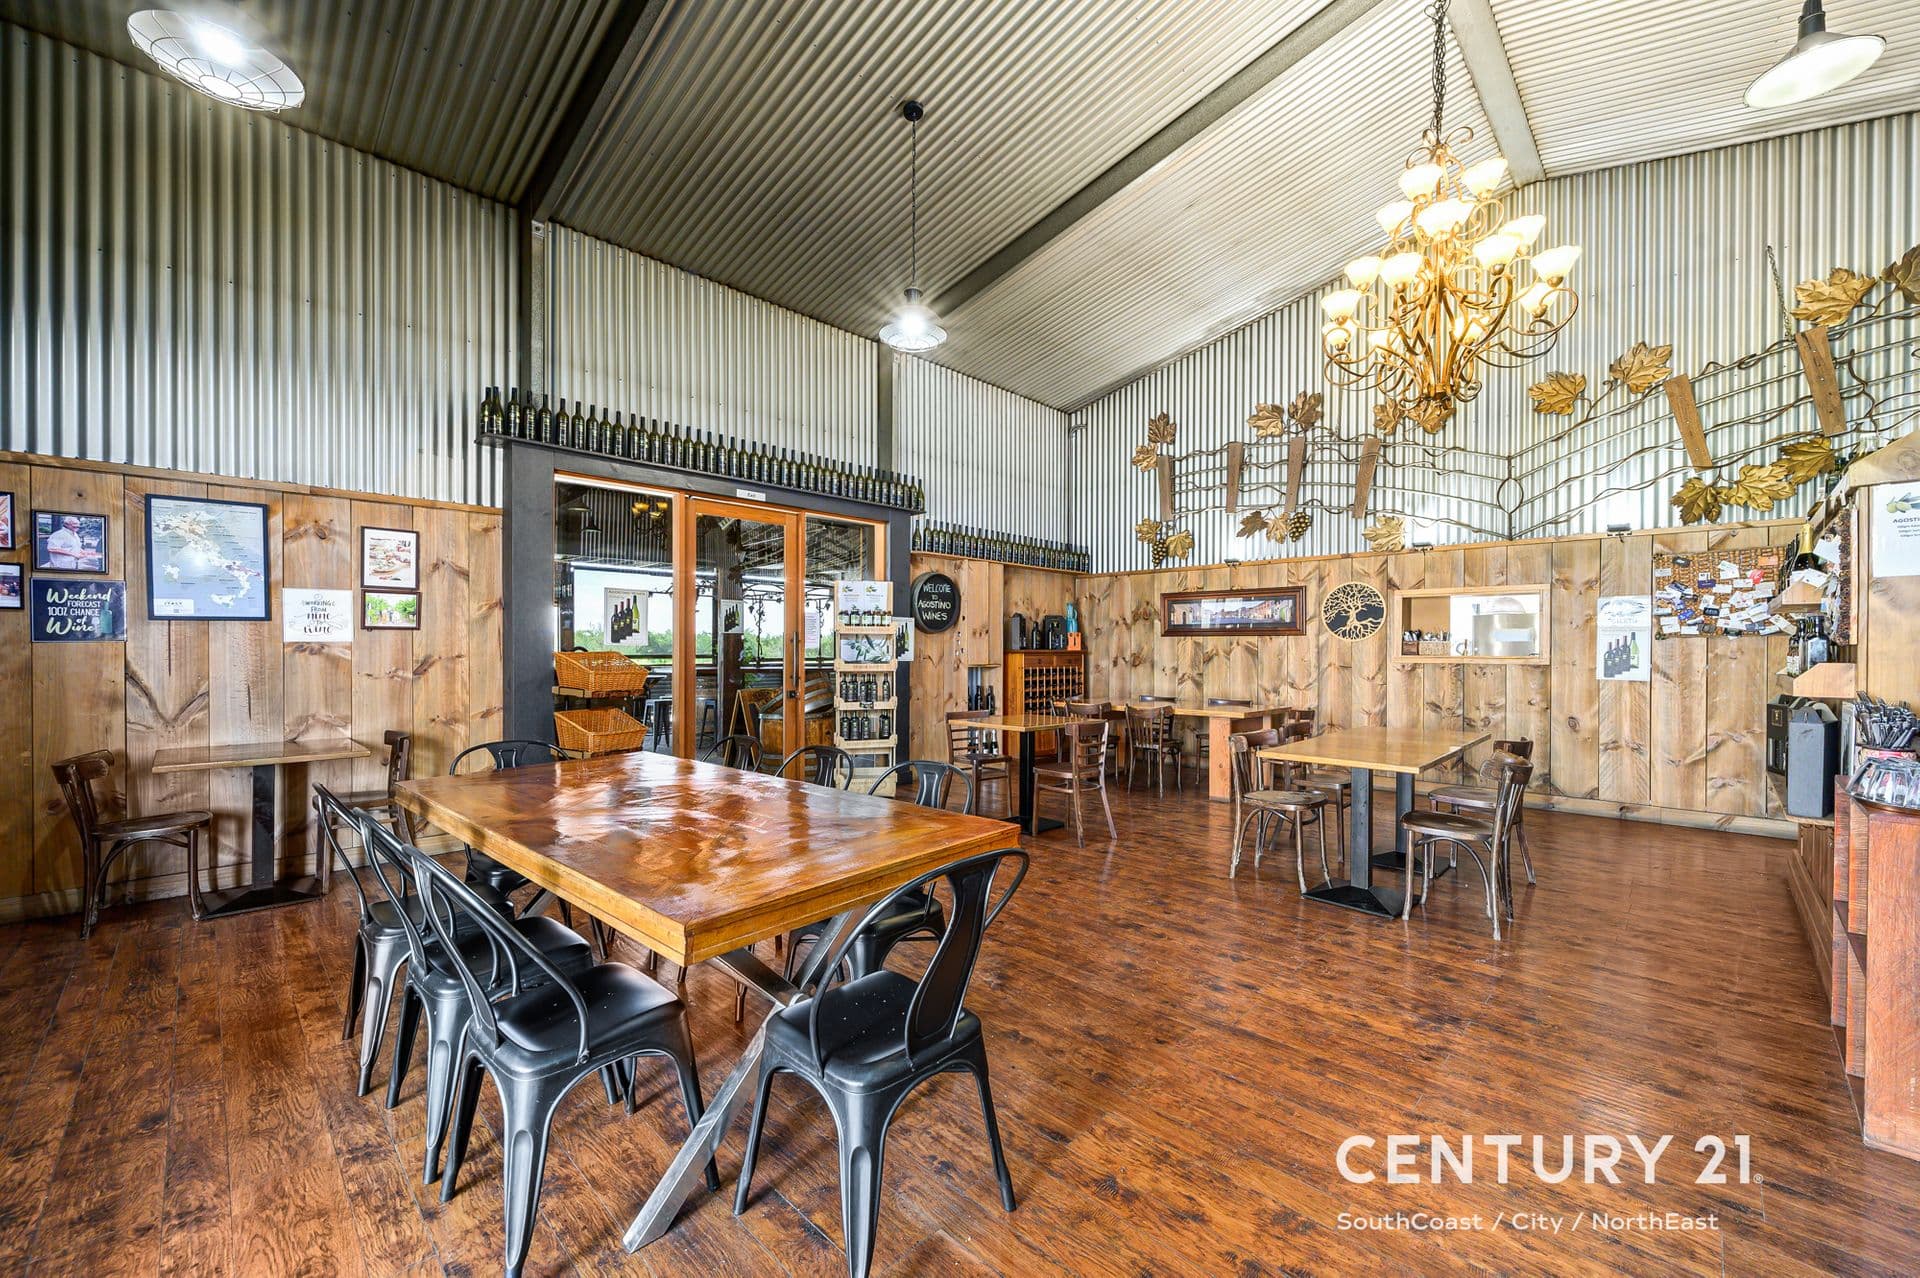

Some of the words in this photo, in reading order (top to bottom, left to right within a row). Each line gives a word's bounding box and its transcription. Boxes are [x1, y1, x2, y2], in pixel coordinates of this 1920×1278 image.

[922, 583, 951, 592] WELCOME
[46, 588, 112, 604] Weekend
[67, 600, 101, 608] FORECAST
[917, 599, 951, 609] AGOSTINO
[69, 608, 100, 617] CHANCE
[922, 611, 948, 620] WINES
[76, 616, 87, 625] of
[46, 617, 96, 635] Wine
